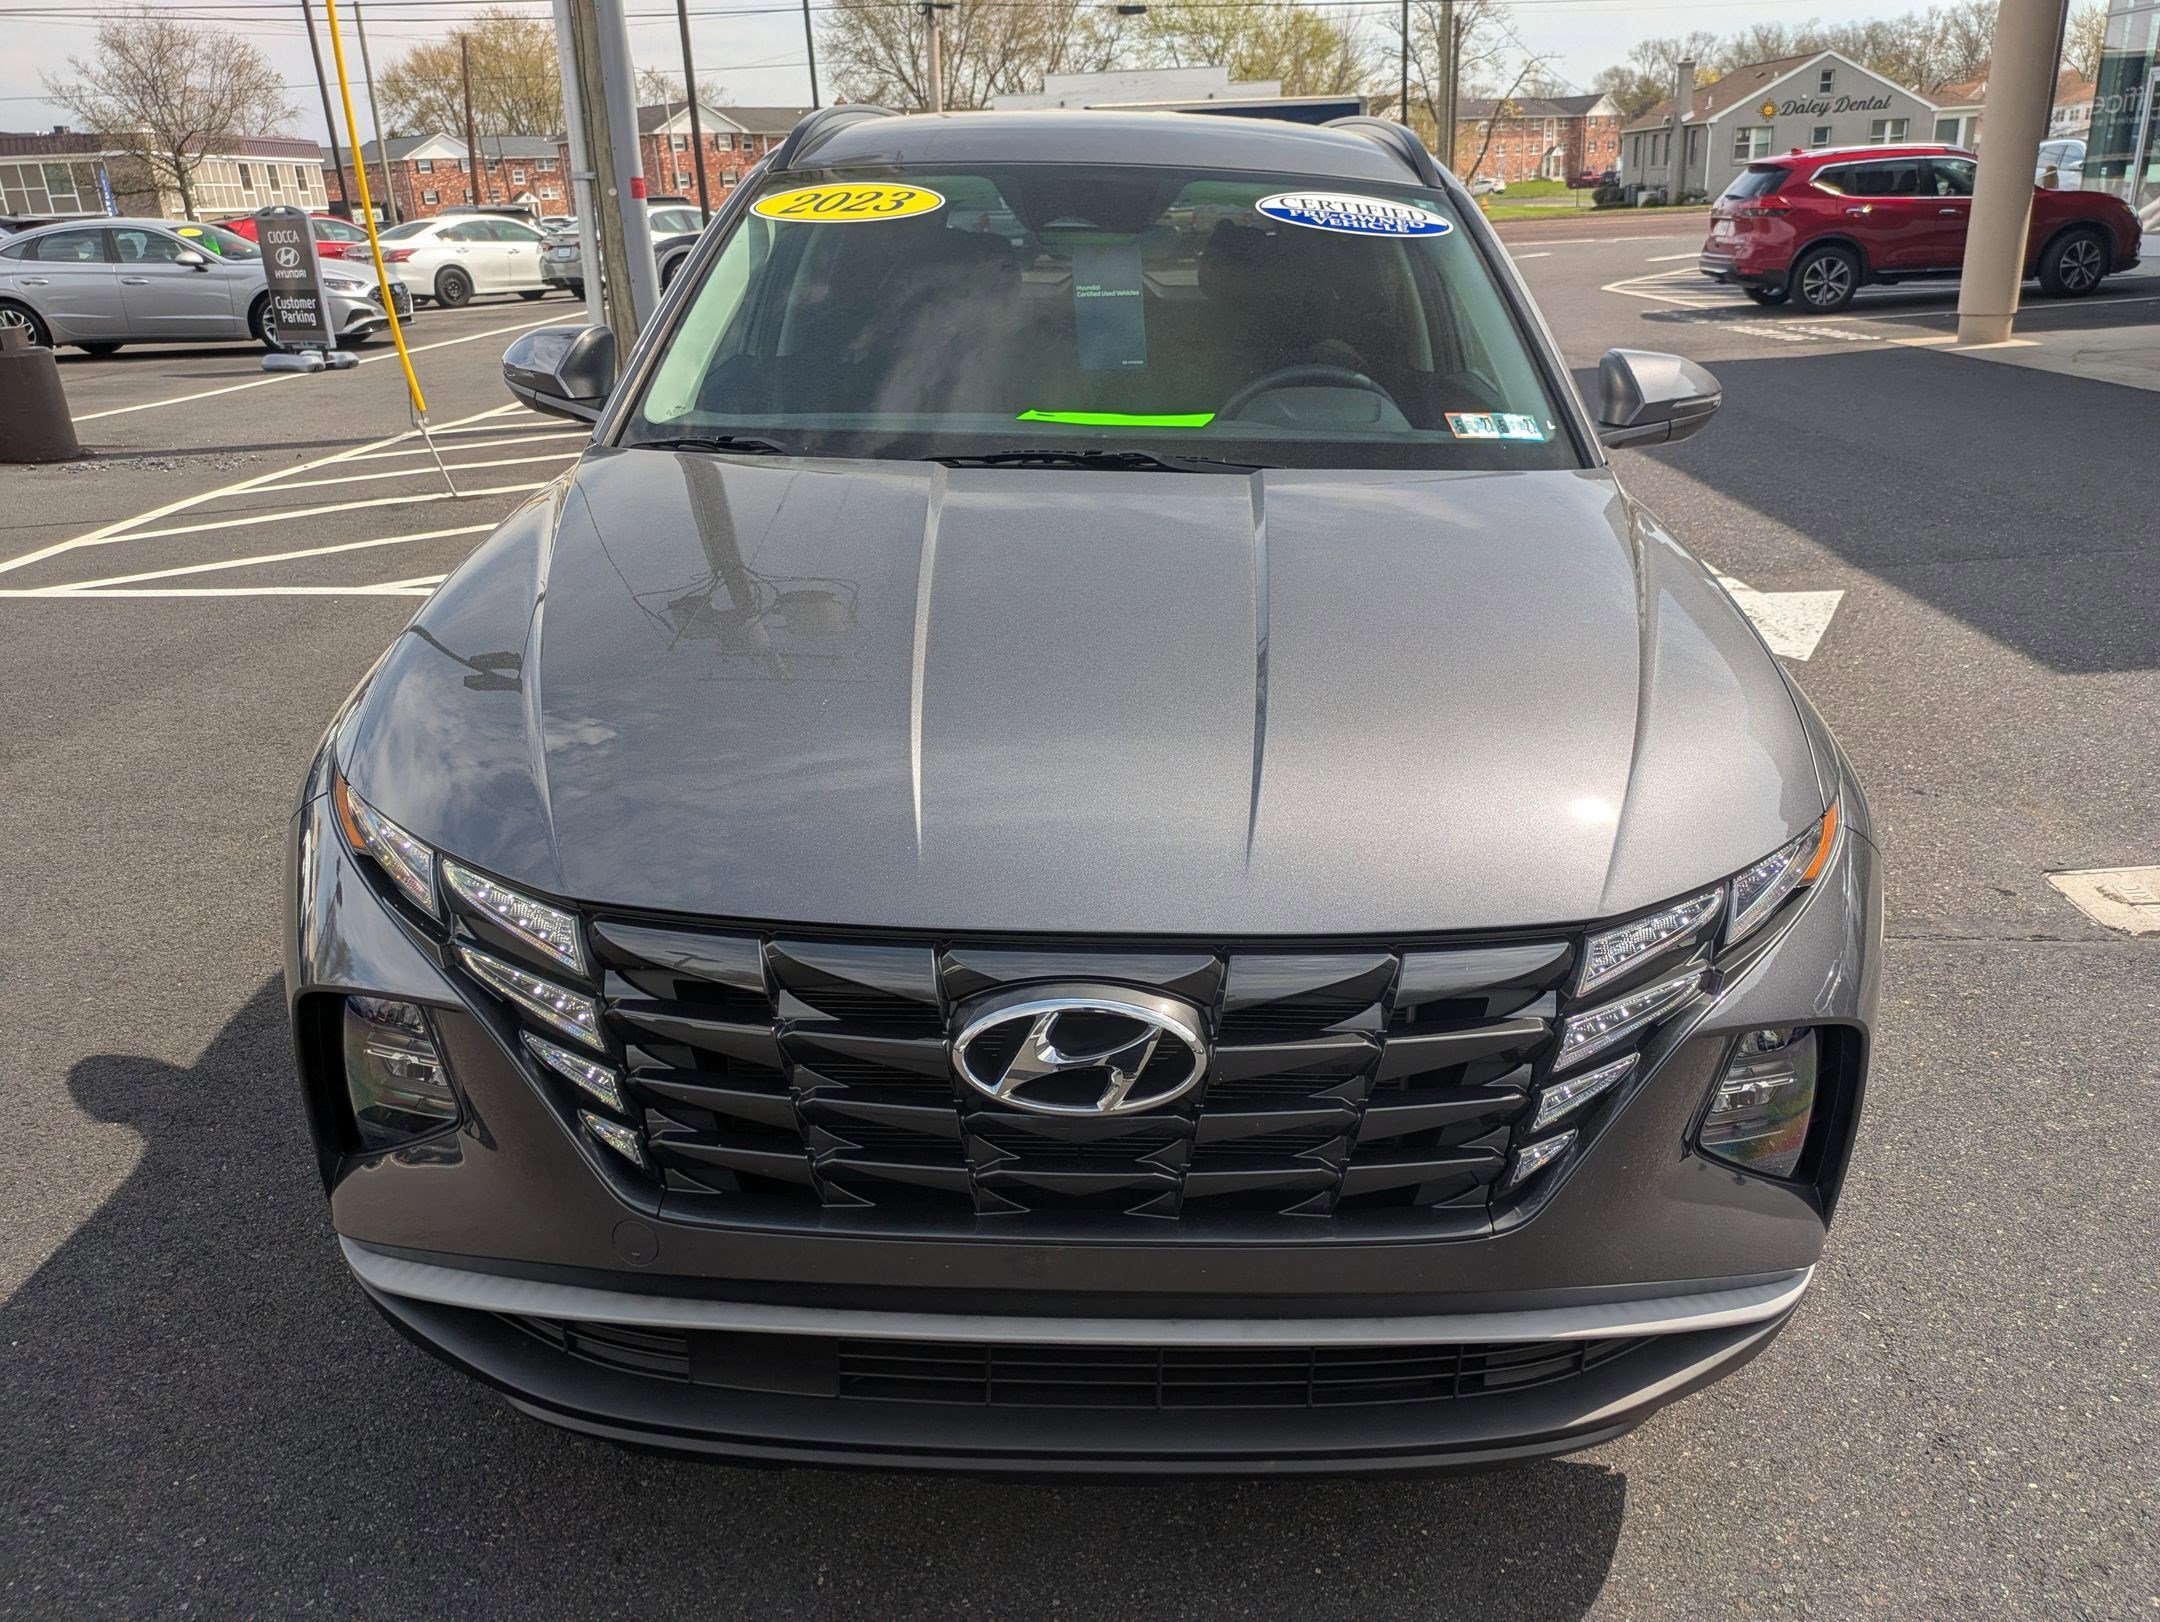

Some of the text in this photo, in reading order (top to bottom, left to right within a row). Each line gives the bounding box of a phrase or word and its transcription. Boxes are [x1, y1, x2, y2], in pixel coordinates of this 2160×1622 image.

[1779, 94, 1892, 118] Daley Dental
[777, 191, 916, 215] 2023
[1279, 197, 1428, 223] CERTIFIED
[1288, 208, 1426, 229] PRE-OWNED
[1311, 216, 1411, 234] VEHICLE
[267, 230, 300, 244] CIOCCA
[274, 269, 307, 279] HYUNDAI
[274, 295, 316, 309] Customer
[281, 310, 317, 327] Parking
